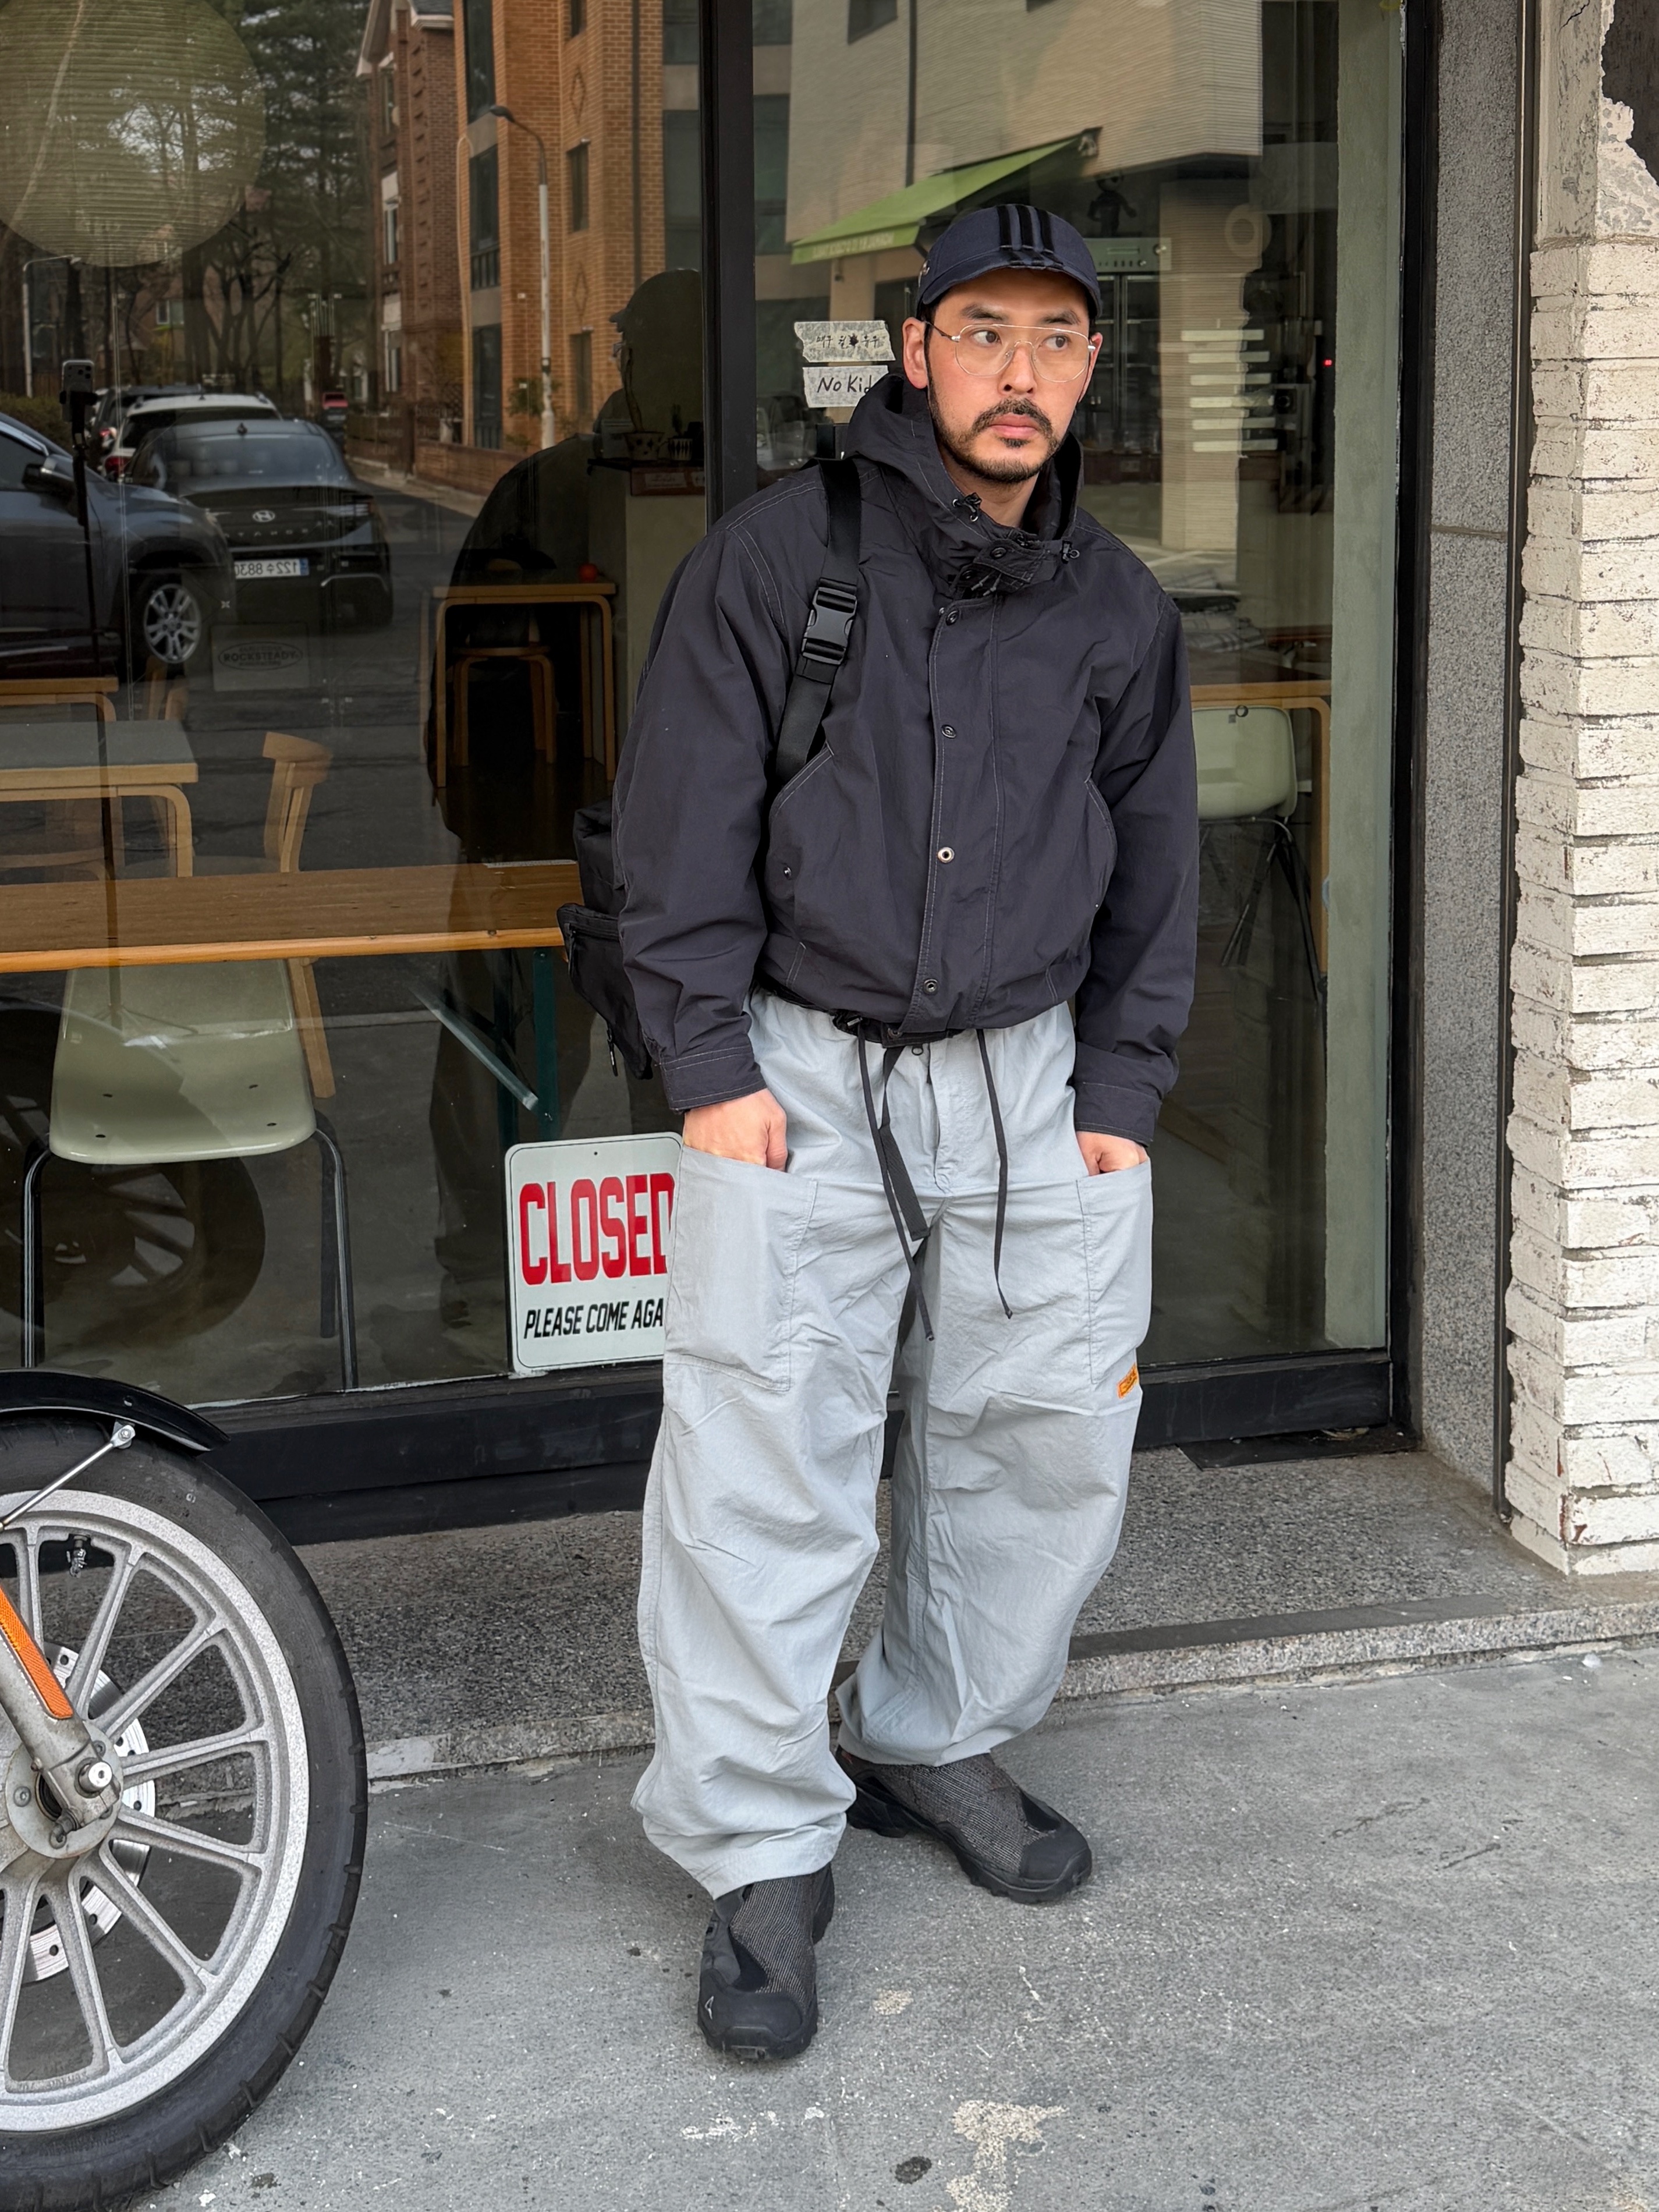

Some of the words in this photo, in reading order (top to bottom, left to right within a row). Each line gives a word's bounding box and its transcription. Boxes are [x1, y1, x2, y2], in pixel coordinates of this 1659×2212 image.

[817, 377, 842, 394] No
[224, 651, 296, 662] ROCKSTEADY
[519, 1172, 675, 1285] CLOSED
[523, 1304, 584, 1339] PLEASE
[586, 1301, 629, 1334] COME
